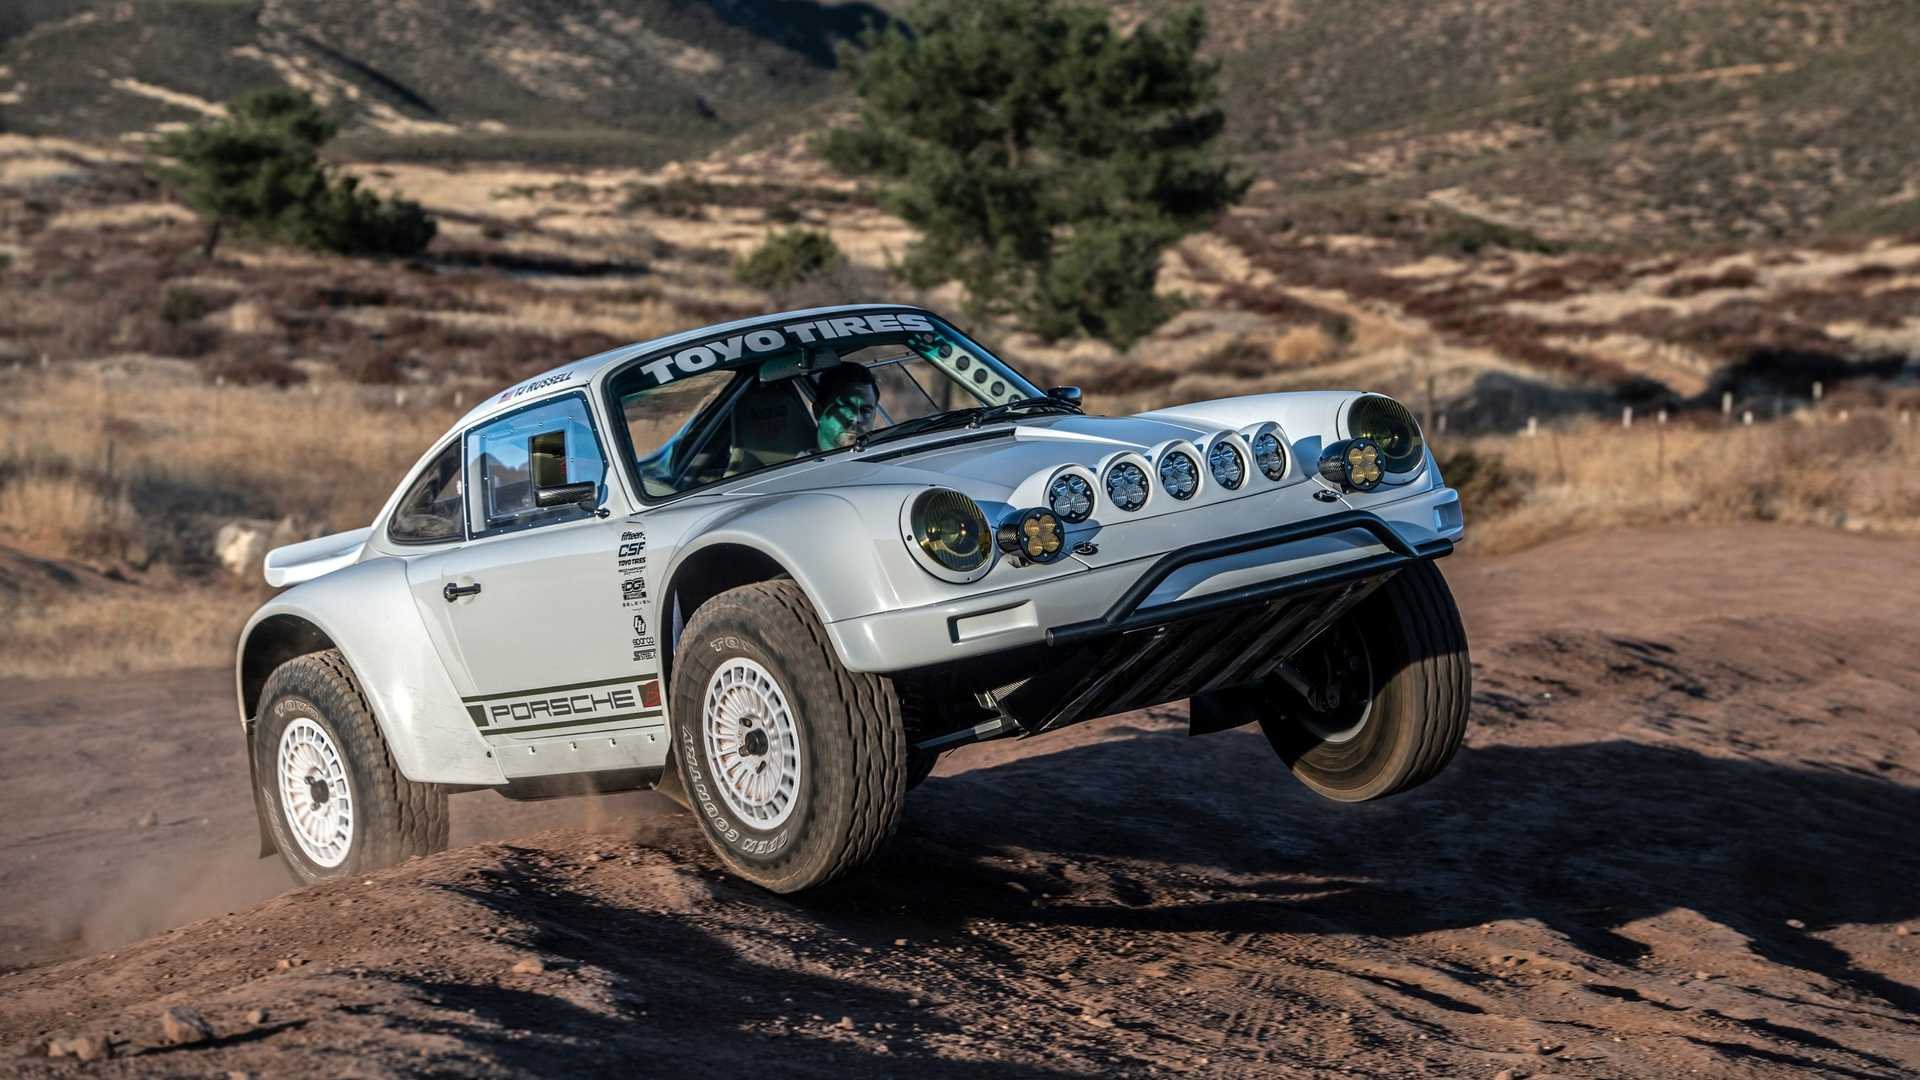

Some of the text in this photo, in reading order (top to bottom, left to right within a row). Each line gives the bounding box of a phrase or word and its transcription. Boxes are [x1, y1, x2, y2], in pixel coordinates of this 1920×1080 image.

[640, 313, 935, 385] TOYO TIRES
[526, 370, 574, 394] RUSSELL
[619, 541, 646, 557] CSF
[490, 689, 636, 723] PORSCHE
